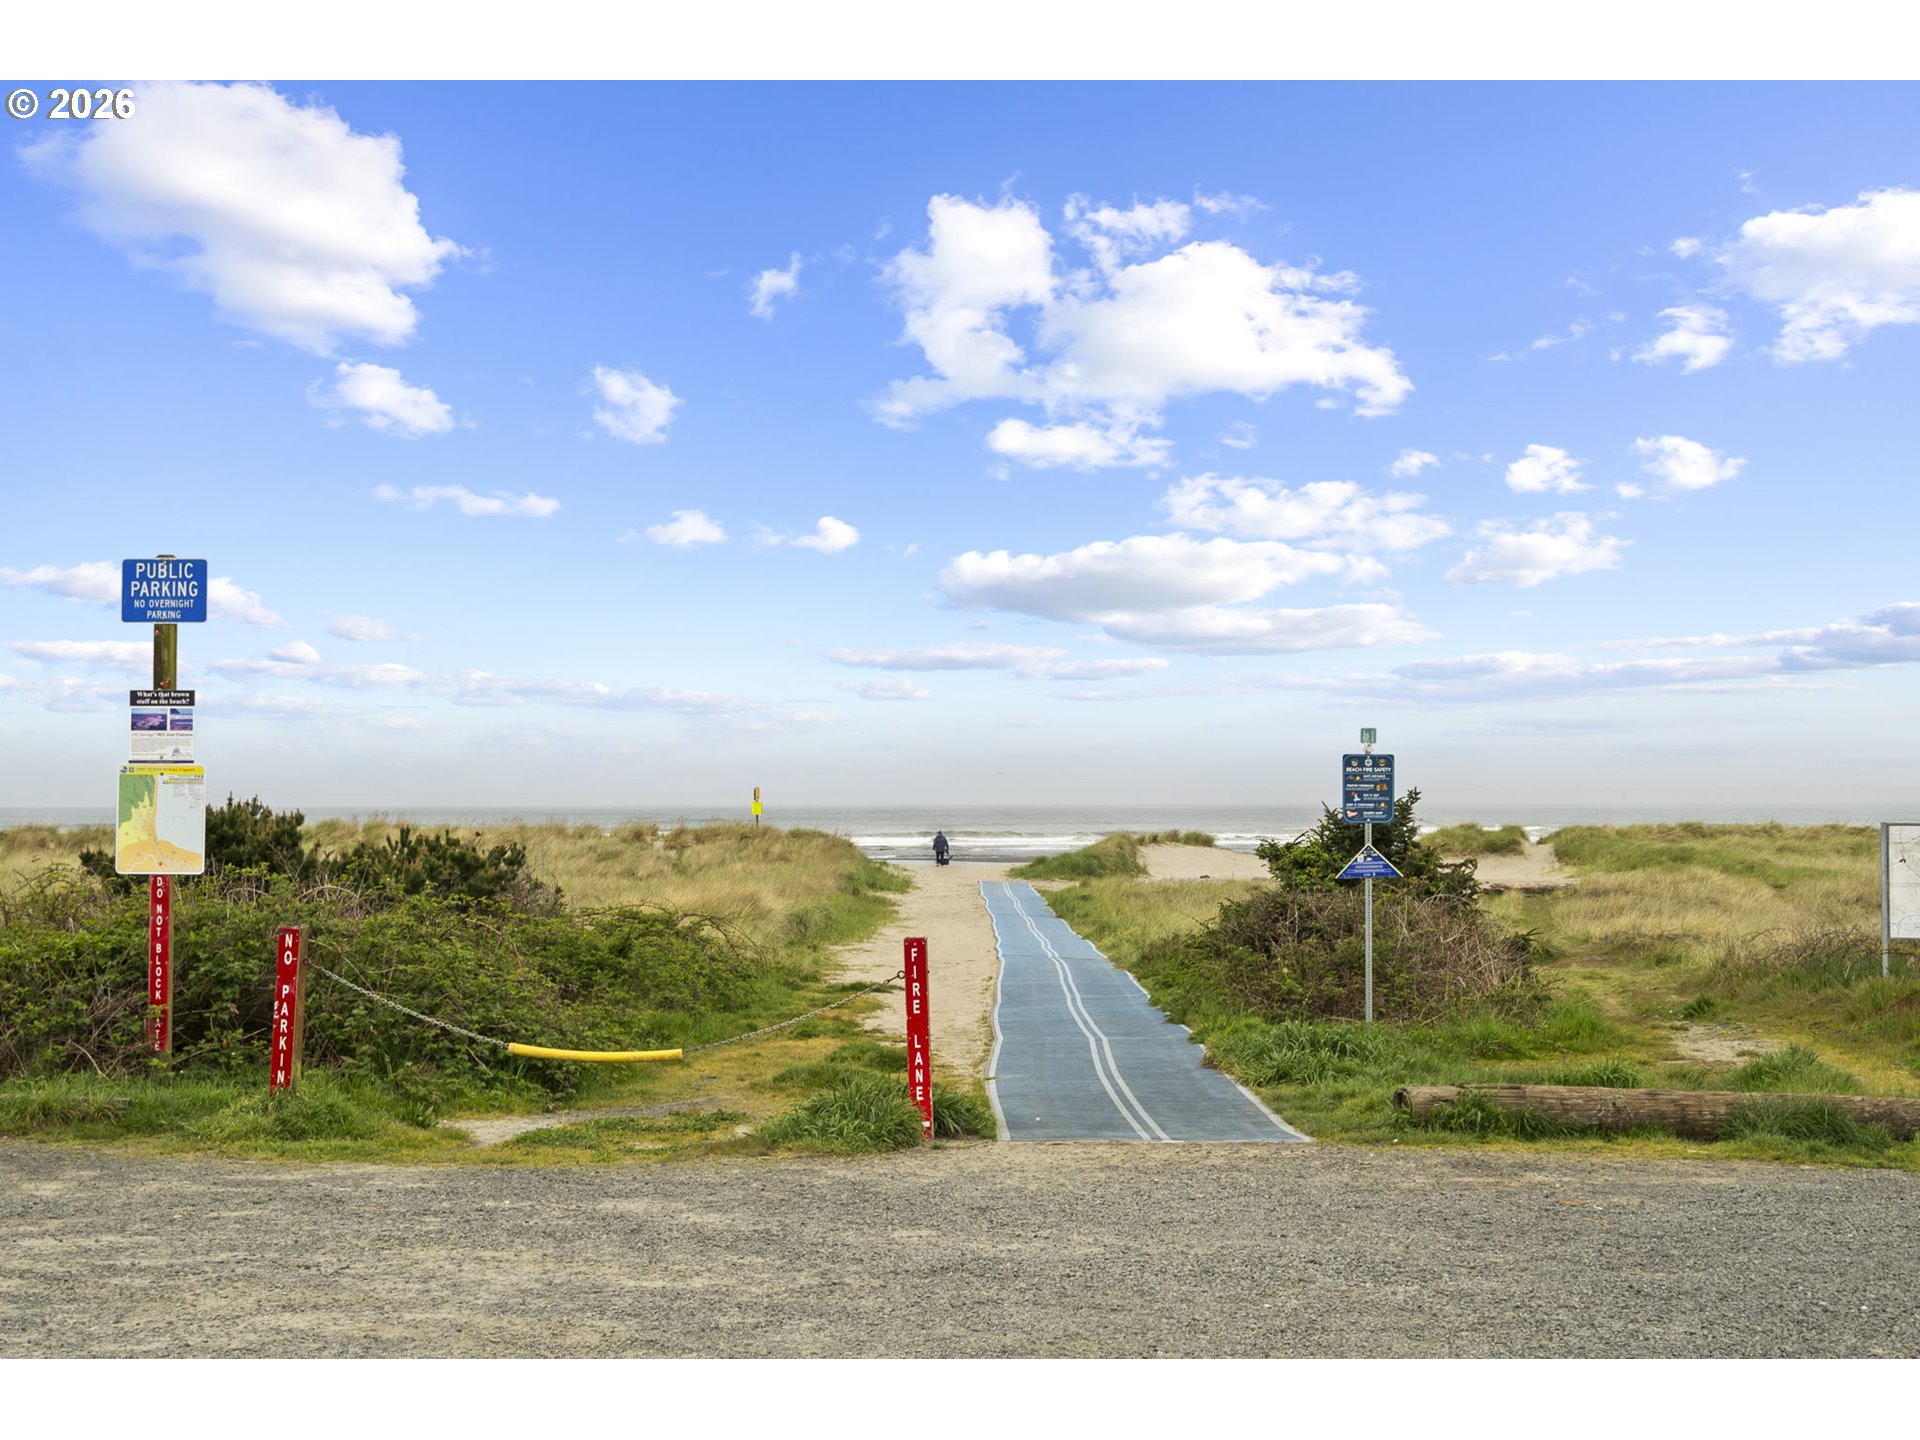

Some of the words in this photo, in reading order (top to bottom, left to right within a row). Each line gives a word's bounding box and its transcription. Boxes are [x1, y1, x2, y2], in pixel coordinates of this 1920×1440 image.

[135, 562, 194, 579] PUBLIC
[130, 580, 199, 598] PARKING
[133, 599, 146, 609] NO
[148, 599, 195, 609] OVERNIGHT
[146, 610, 182, 620] PARKING
[156, 876, 163, 898] DO
[283, 933, 293, 965] NO
[155, 943, 163, 1000] BLOCK
[911, 948, 921, 1014] FIRE
[914, 1034, 924, 1101] LANE
